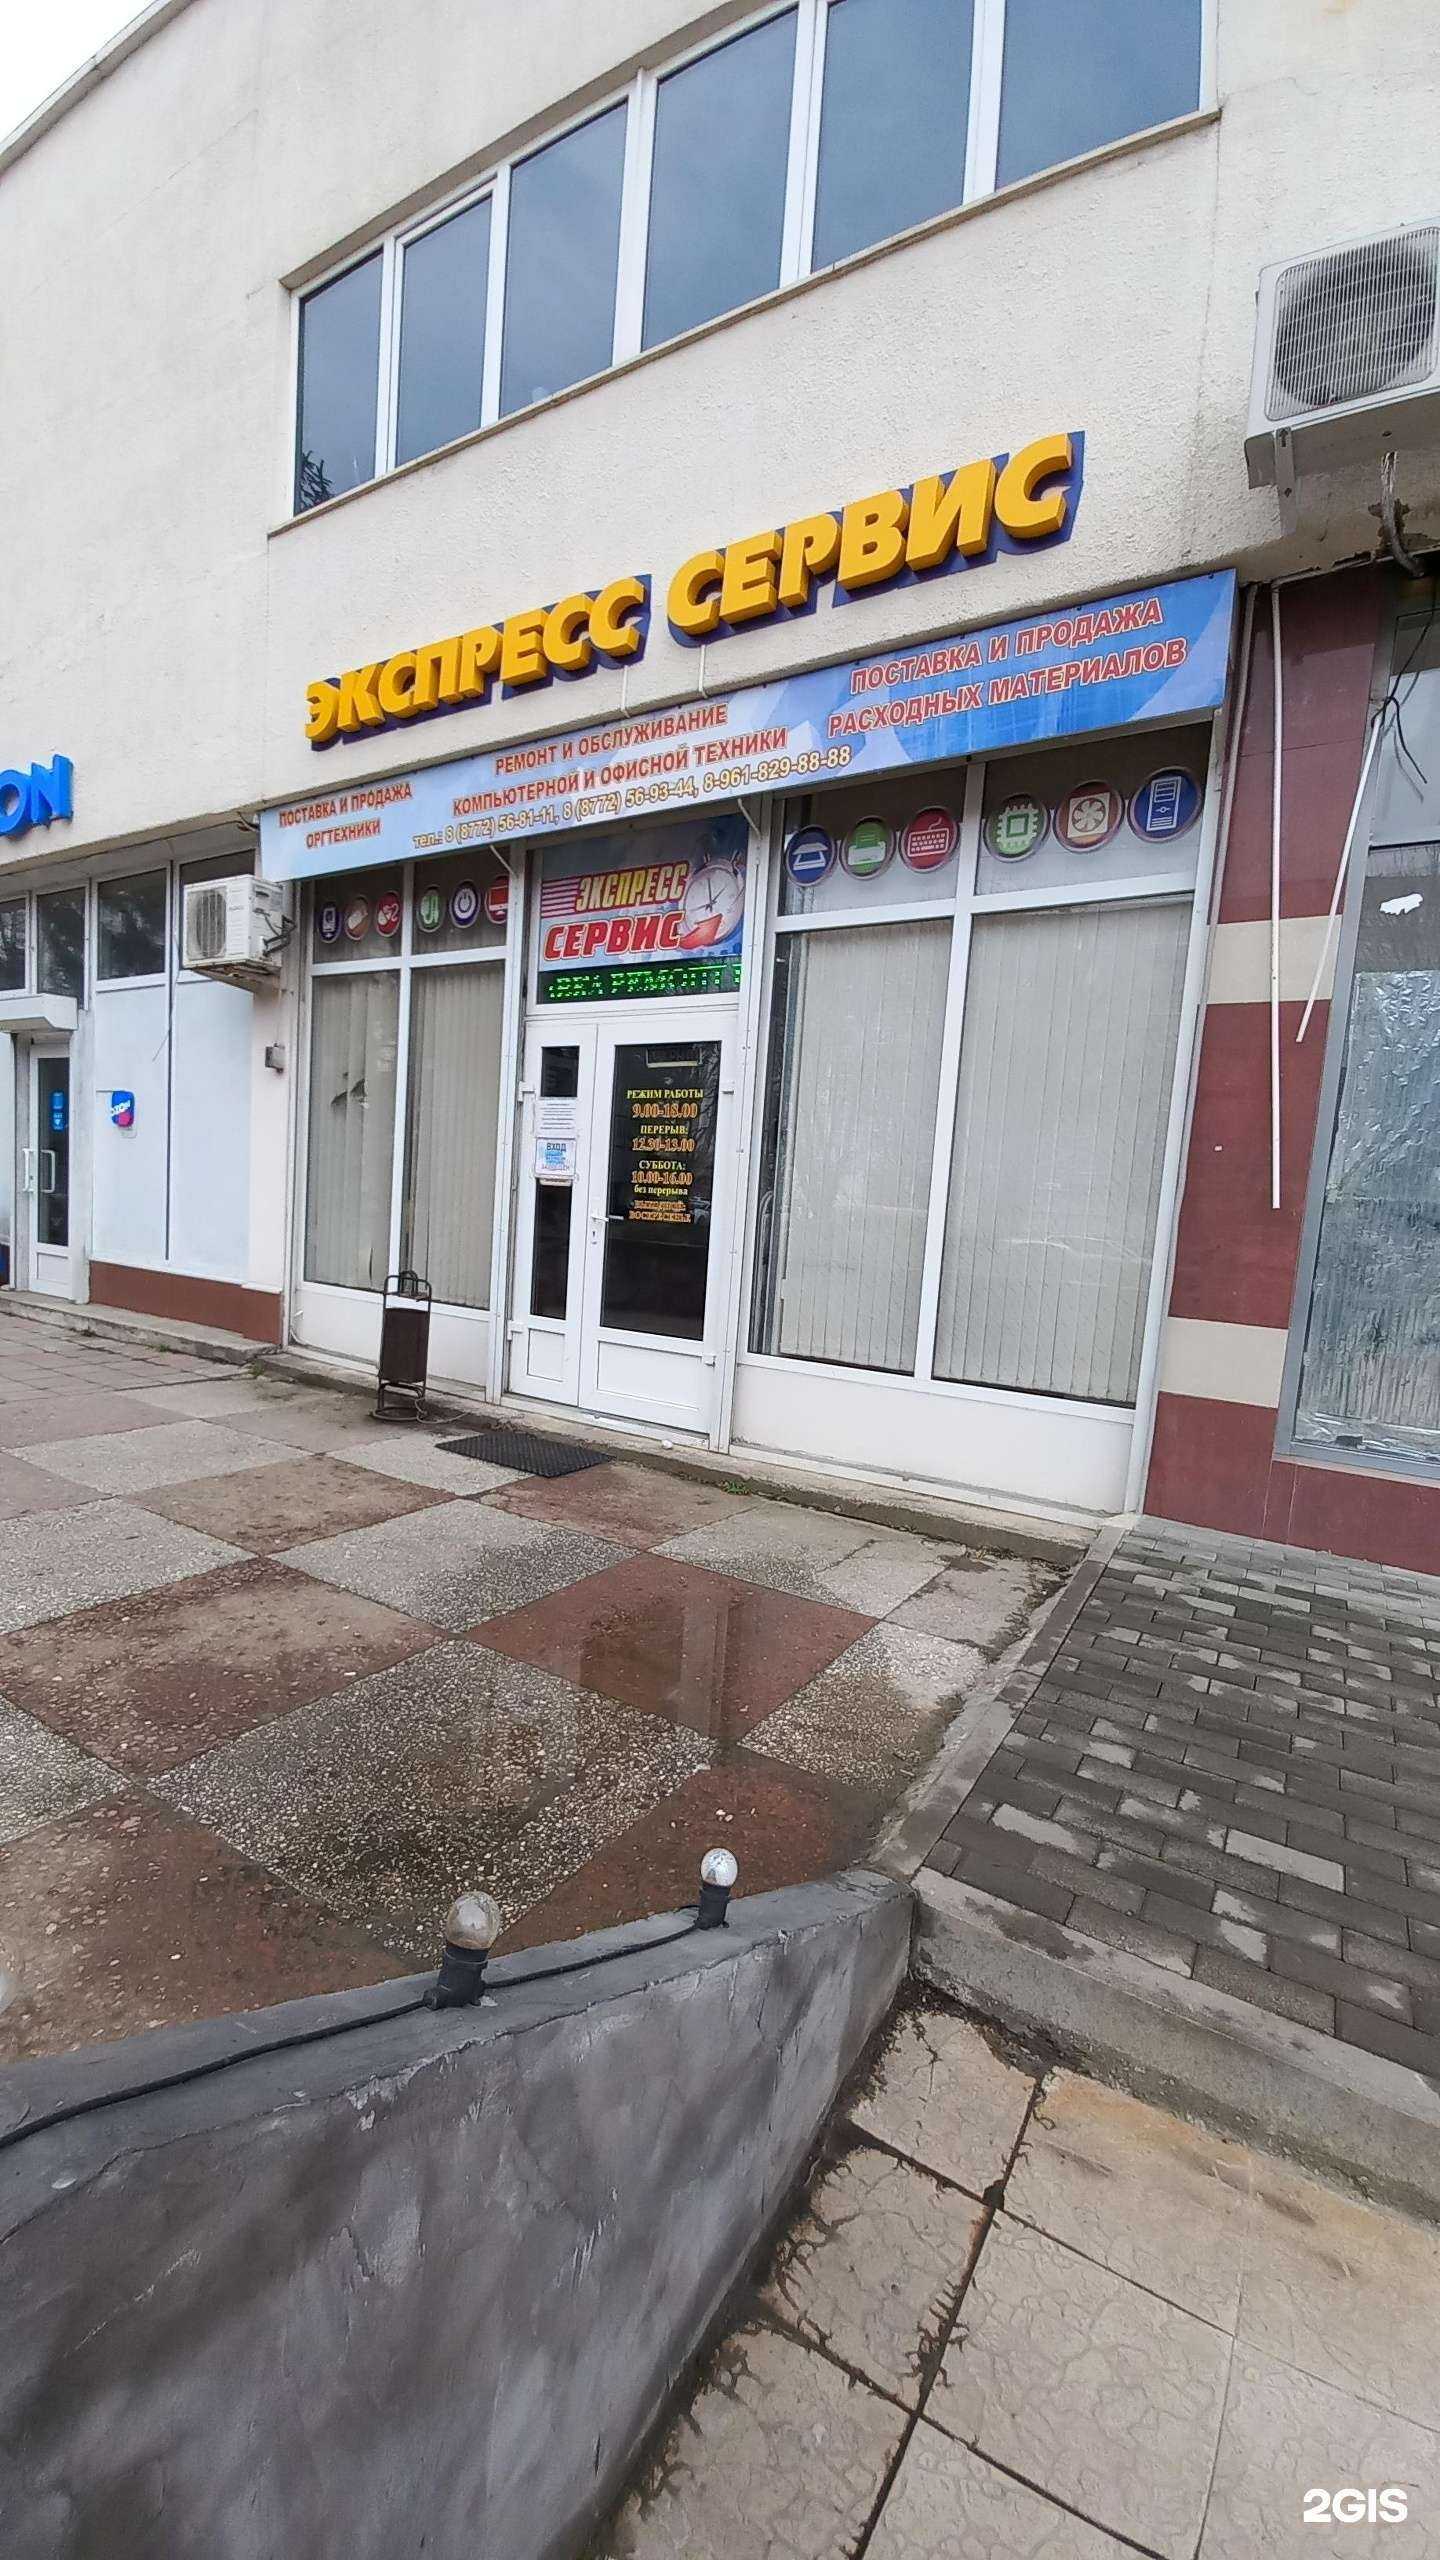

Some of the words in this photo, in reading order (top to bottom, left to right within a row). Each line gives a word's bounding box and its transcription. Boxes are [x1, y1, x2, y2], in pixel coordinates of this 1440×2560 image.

[305, 574, 650, 746] ЭКСПРЕСС
[667, 431, 1080, 640] СЕРВИС
[850, 641, 982, 695] ПОСТАВКА
[988, 634, 1009, 663] И
[1016, 598, 1163, 656] ПРОДАЖА
[827, 682, 984, 738] РАСХОДНЫХ
[988, 637, 1188, 706] МАТЕРИАЛОВ
[495, 745, 557, 776] РЕМОНТ
[563, 741, 574, 760] И
[579, 703, 729, 757] ОБСЛУЖИВАНИЕ
[444, 825, 454, 843] 8
[455, 818, 495, 844] (8772)
[498, 805, 560, 832] 56-81-11,
[563, 801, 573, 820] 8
[575, 791, 622, 824] (8772)
[625, 777, 698, 811] 56-93-44,
[702, 745, 852, 794] 8-961-829-88-88
[453, 770, 580, 816] КОМПЬЮТЕРНОЙ
[584, 768, 595, 789] И
[600, 743, 689, 786] ОФИСНОЙ
[696, 727, 789, 765] ТЕХНИКИ
[278, 804, 337, 828] ПОСТАВКА
[338, 799, 349, 815] И
[350, 781, 413, 811] ПРОДАЖА
[306, 819, 381, 849] ОРГТЕХНИКИ
[575, 862, 689, 912] ЭКСПРЕСС
[544, 911, 685, 961] СЕРВИС
[627, 1089, 662, 1099] РЕЖИМ
[664, 1088, 704, 1098] РАБОТЫ
[631, 1102, 698, 1118] 9.00-18.00
[640, 1124, 689, 1135] ПЕРЕРЫВ:
[638, 1160, 687, 1170] СУББОТА:
[634, 1184, 647, 1194] без
[648, 1186, 688, 1197] перерыва
